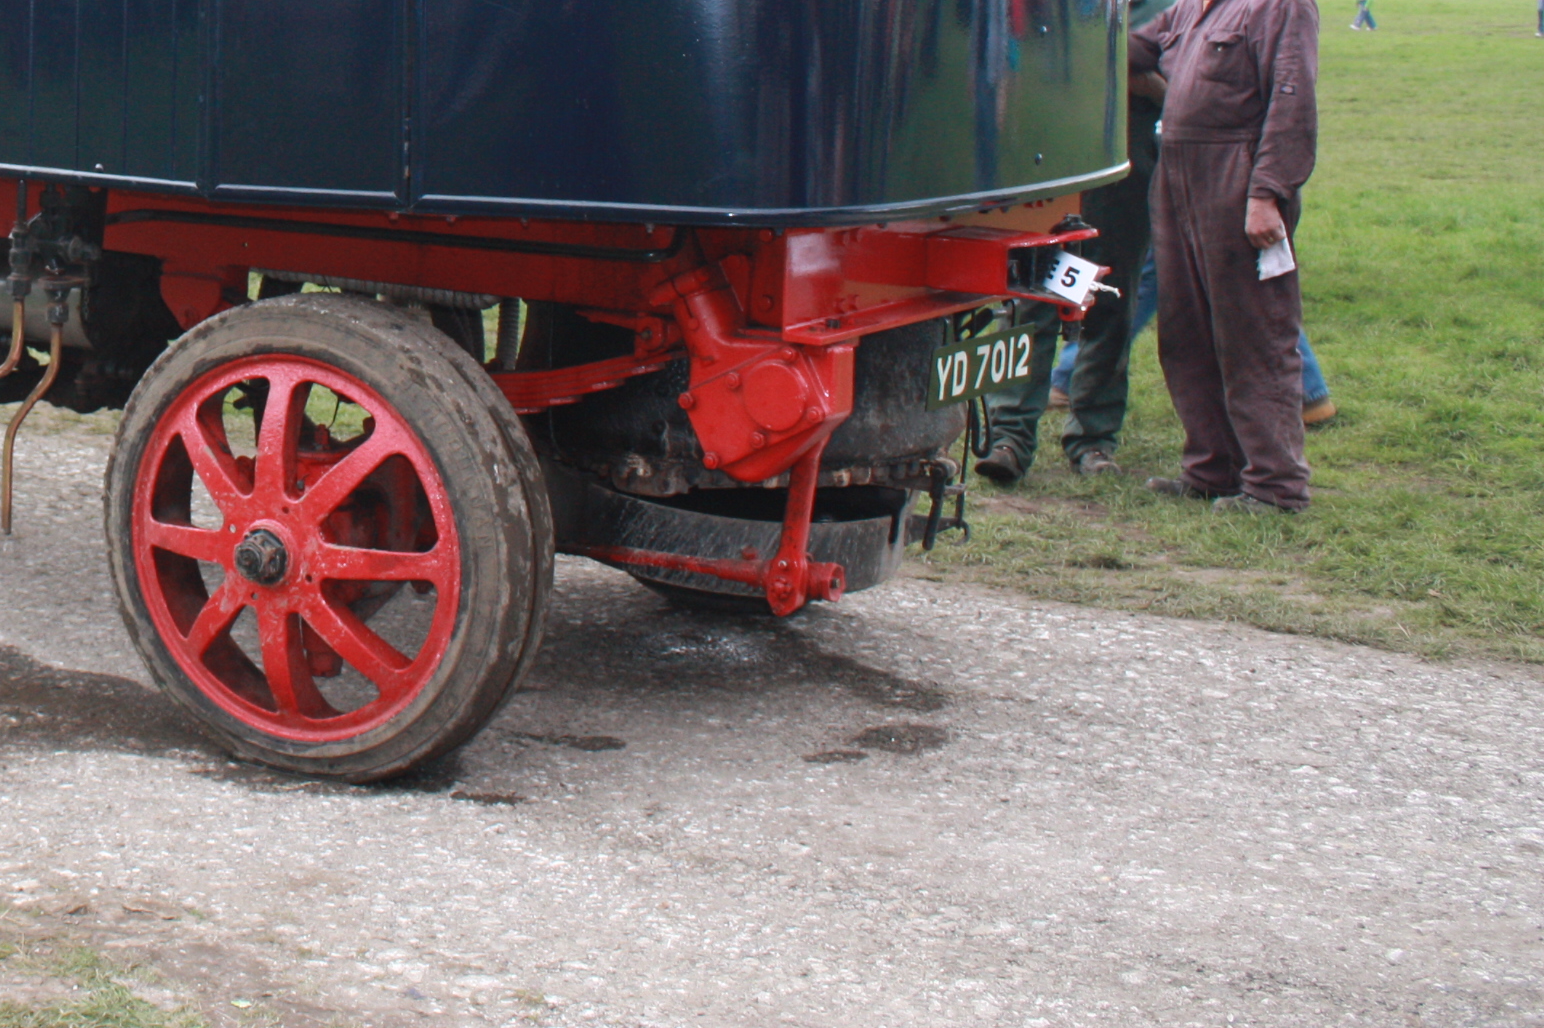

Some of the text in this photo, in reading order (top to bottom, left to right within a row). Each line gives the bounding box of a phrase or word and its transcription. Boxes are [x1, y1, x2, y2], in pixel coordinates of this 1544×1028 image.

[1061, 265, 1081, 288] 5
[937, 333, 1031, 401] YD 7012
